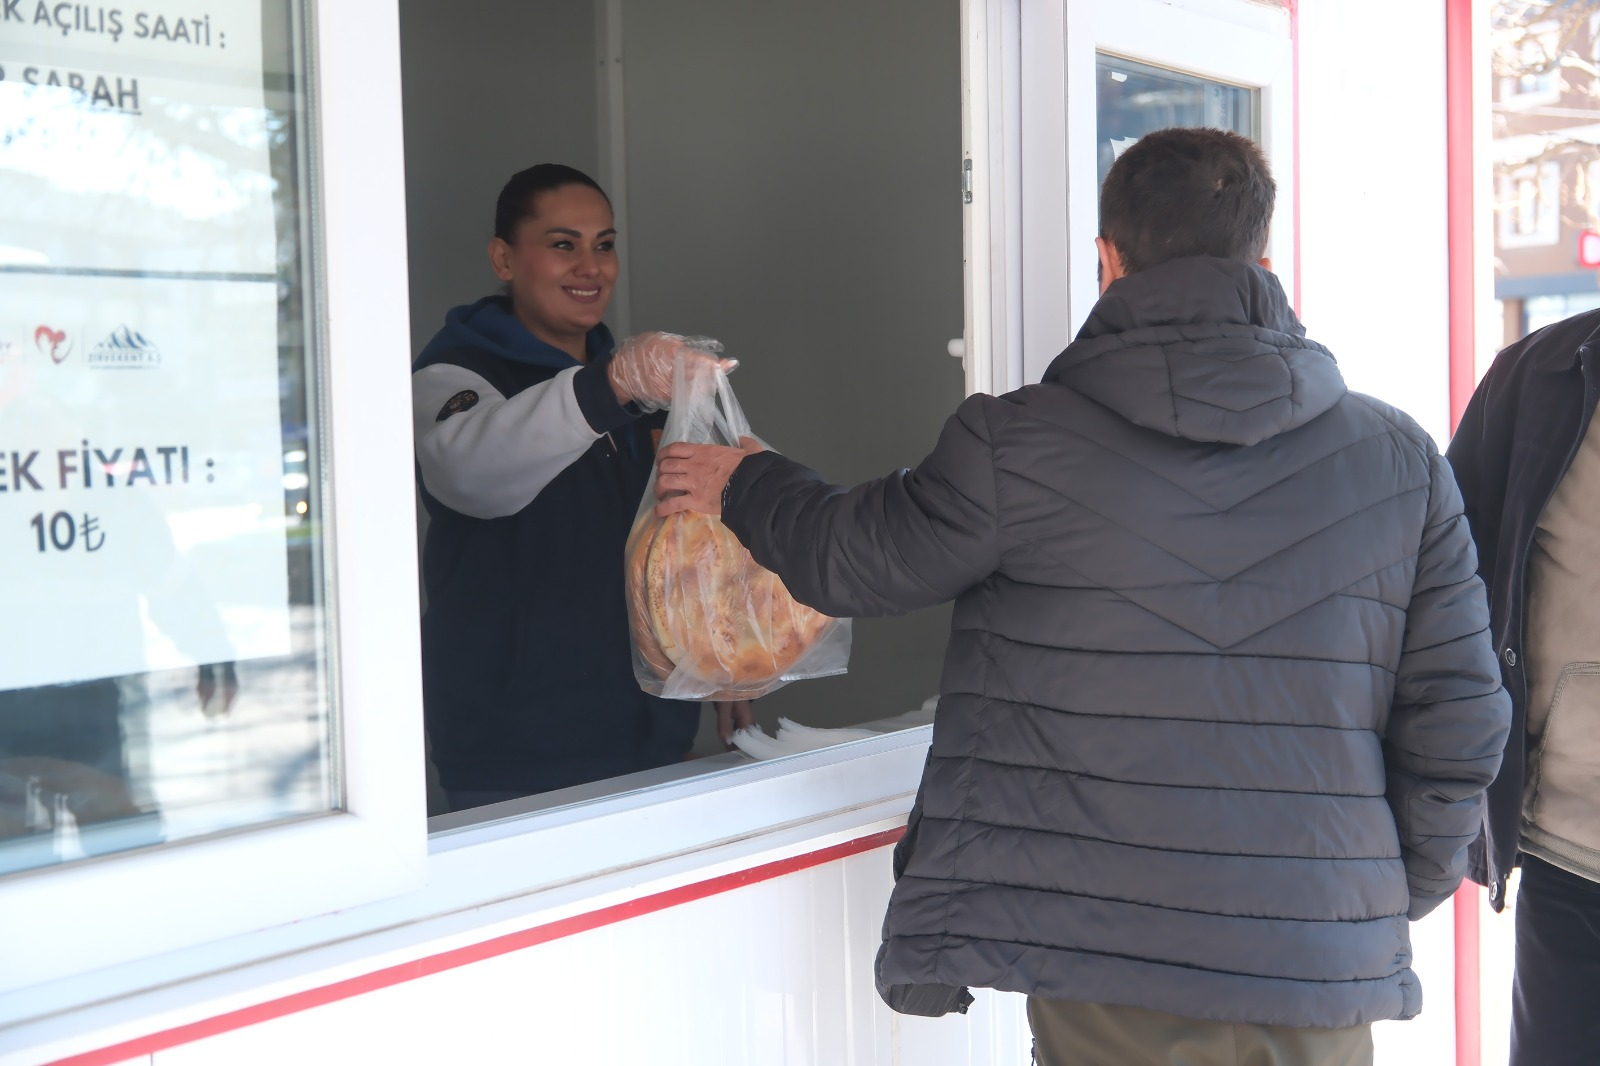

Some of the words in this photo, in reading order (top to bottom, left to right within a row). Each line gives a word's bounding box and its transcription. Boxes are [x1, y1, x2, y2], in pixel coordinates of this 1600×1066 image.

[0, 0, 24, 22] K
[33, 0, 123, 42] AÇILIŞ
[134, 13, 210, 46] SAATİ
[57, 438, 189, 490] FİYATI
